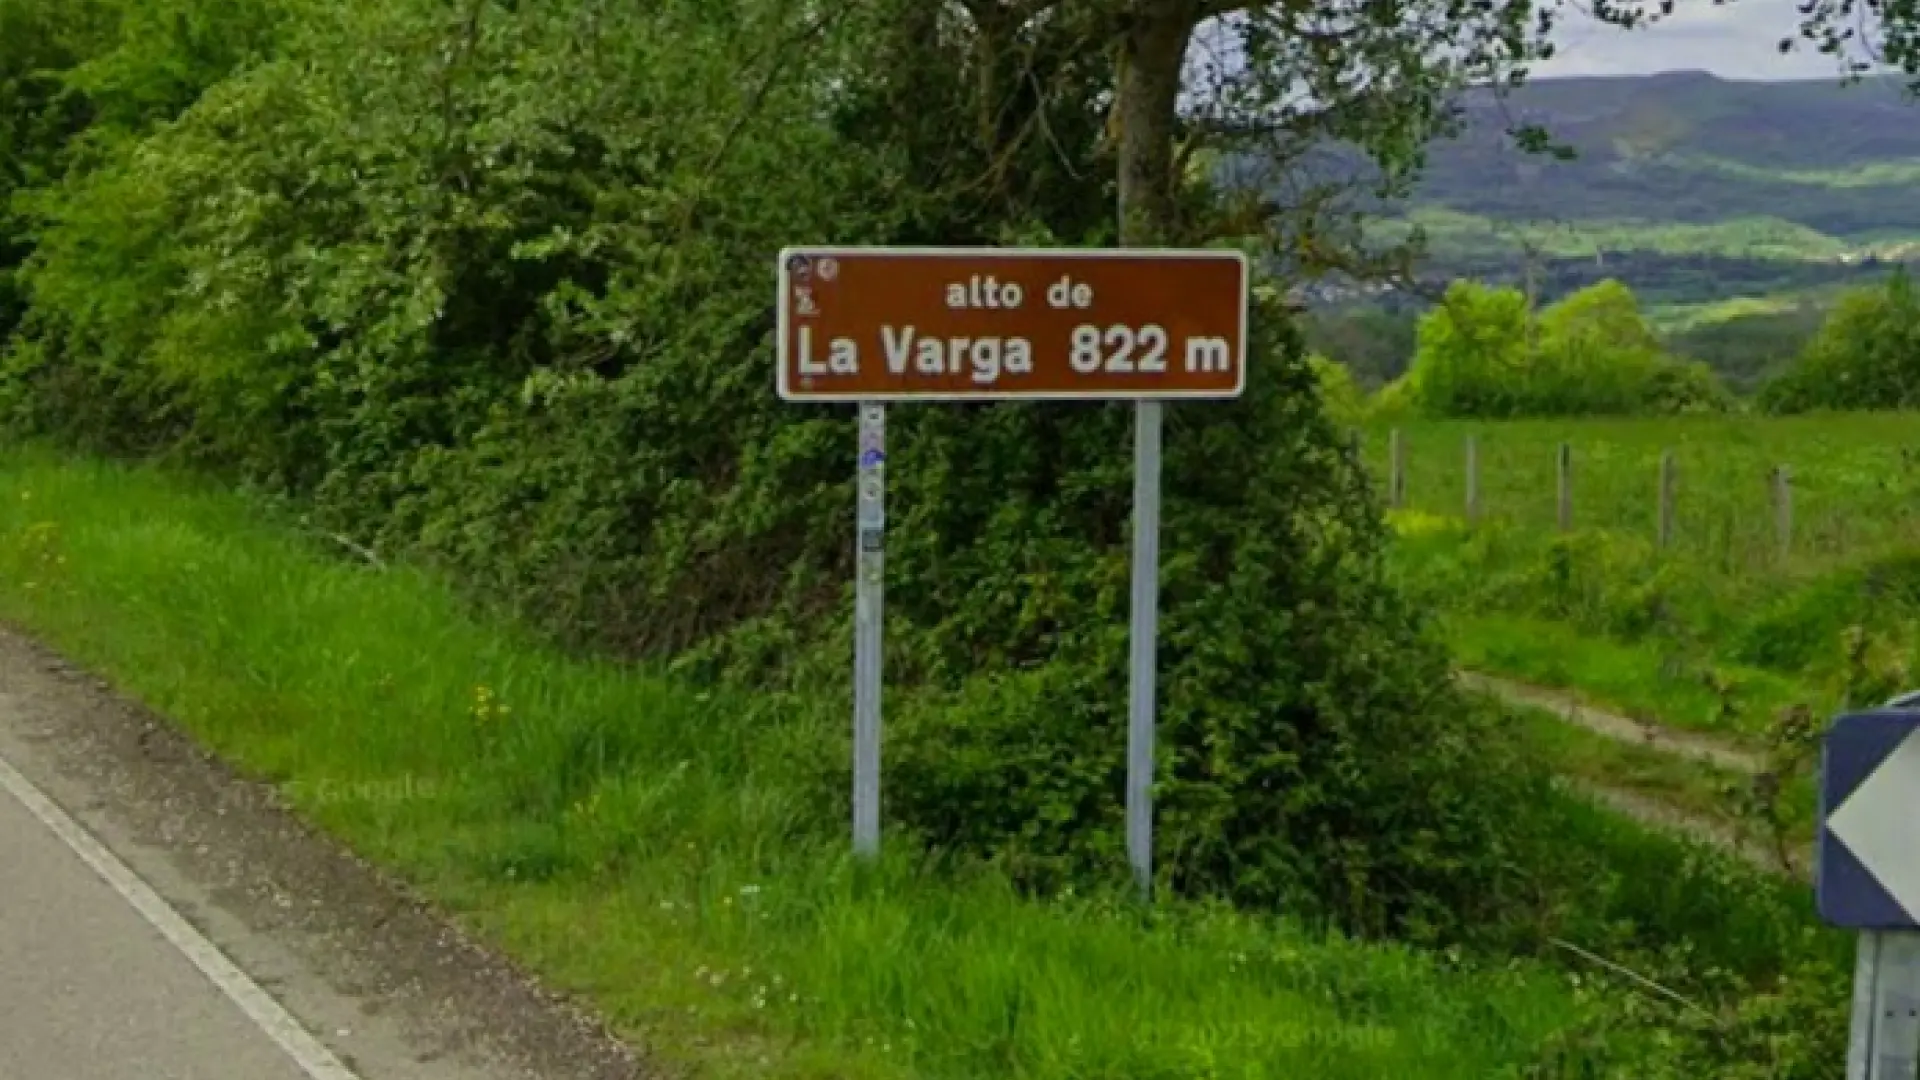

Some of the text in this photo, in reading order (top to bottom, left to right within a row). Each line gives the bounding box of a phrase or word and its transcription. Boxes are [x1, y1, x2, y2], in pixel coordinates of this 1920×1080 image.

[947, 276, 1092, 307] alto de
[798, 324, 1230, 384] La Varga 822 m
